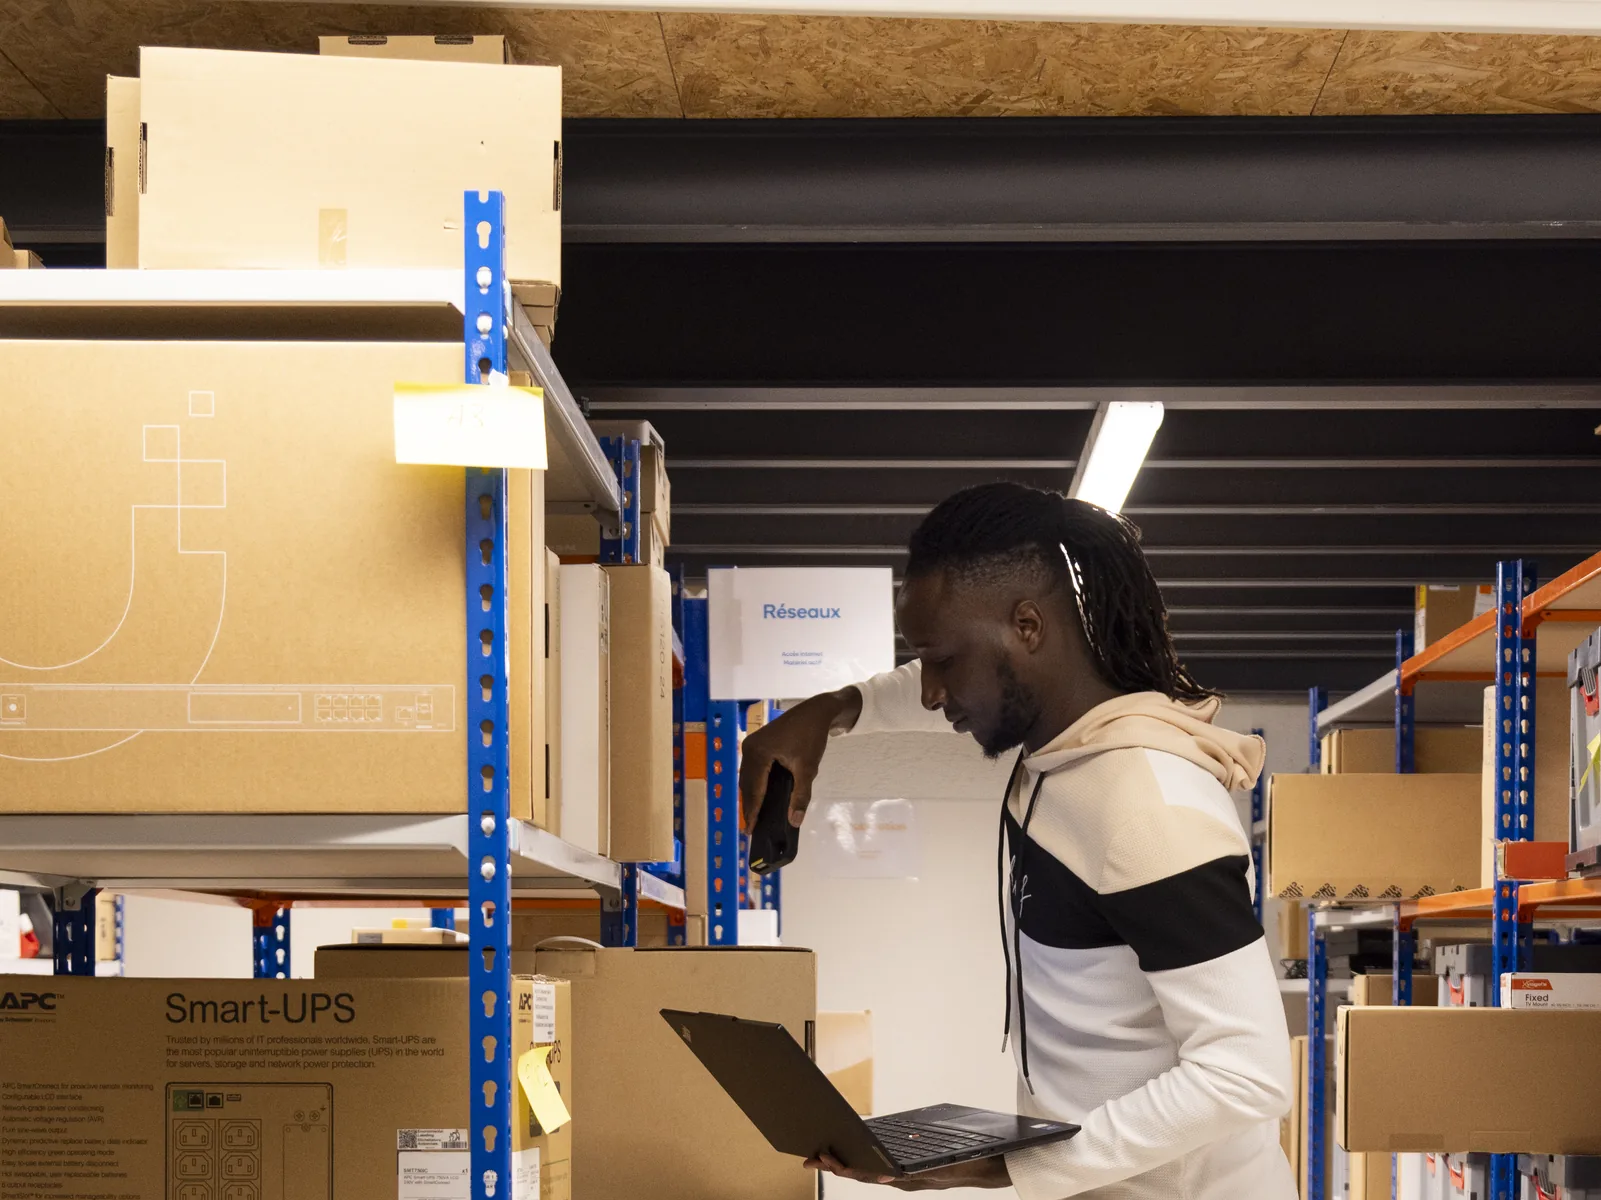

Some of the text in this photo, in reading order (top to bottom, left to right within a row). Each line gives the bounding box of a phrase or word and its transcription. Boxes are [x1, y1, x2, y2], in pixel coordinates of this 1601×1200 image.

[763, 603, 841, 619] Réseaux
[1525, 993, 1549, 1002] Fixed
[165, 992, 356, 1024] Smart-UPS
[166, 1035, 198, 1045] Trusted
[200, 1035, 211, 1046] by
[214, 1035, 244, 1045] millions
[246, 1035, 255, 1045] of
[266, 1035, 322, 1046] professionals
[372, 1034, 419, 1045] Smart-UPS
[421, 1037, 436, 1045] are
[166, 1046, 444, 1059] the most popular uninterruptible power supplies (UPS) in the world
[166, 1059, 177, 1068] for
[214, 1060, 247, 1070] storage
[249, 1059, 265, 1068] and
[267, 1059, 300, 1068] network
[302, 1060, 329, 1070] power
